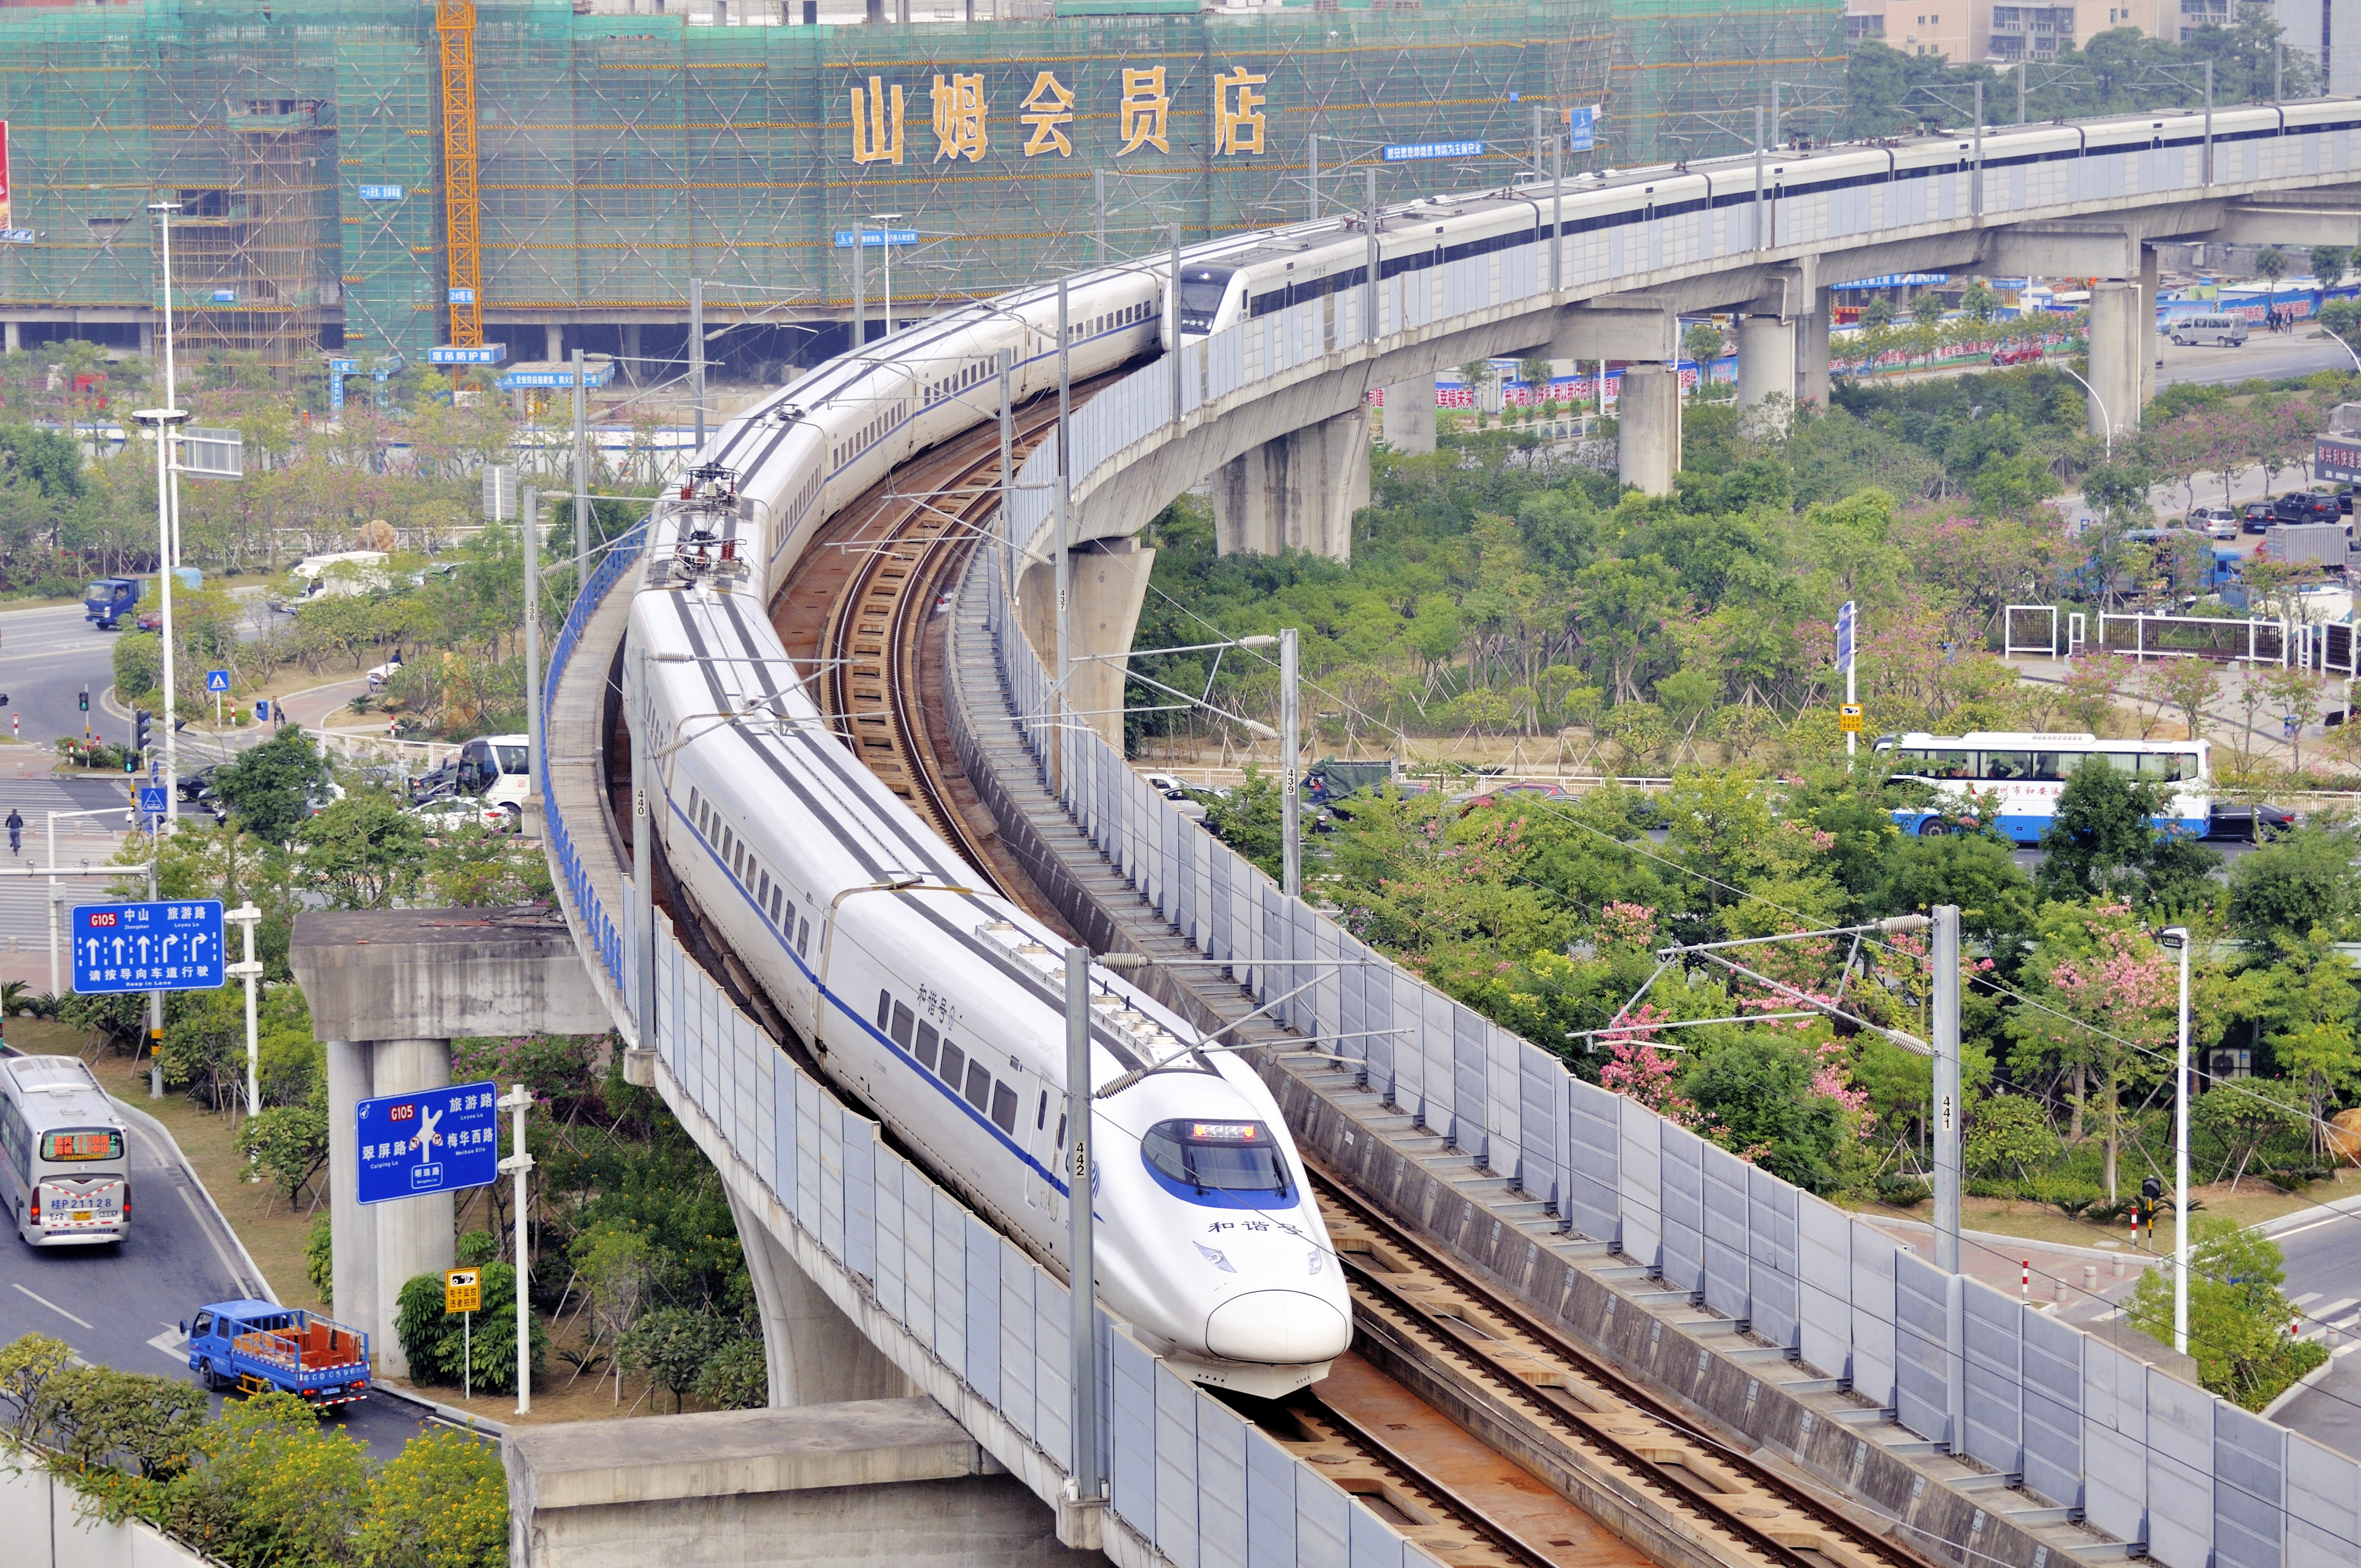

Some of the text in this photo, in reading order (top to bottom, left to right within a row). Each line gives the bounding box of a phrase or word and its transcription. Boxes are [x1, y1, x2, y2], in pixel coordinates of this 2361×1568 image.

[851, 66, 1266, 165] 山姆会员店
[450, 291, 473, 301] 2#塔吊
[433, 352, 489, 361] 塔吊防护棚
[91, 914, 116, 926] G105
[124, 908, 149, 922] 中山
[167, 906, 206, 921] 旅游路
[89, 965, 209, 982] 请按导向车道行驶
[917, 983, 948, 1024] 和谐号
[449, 1092, 493, 1113] 旅游路
[391, 1105, 414, 1120] G105
[448, 1127, 494, 1148] 梅华西路
[91, 1144, 110, 1153] 中山
[362, 1140, 407, 1162] 翠屏路
[1076, 1141, 1085, 1175] 442
[415, 1166, 440, 1178] 明珠路
[51, 1199, 112, 1209] 桂P21128
[1207, 1221, 1304, 1235] 和谐号
[450, 1288, 477, 1298] 电子监控
[450, 1298, 477, 1308] 违者拍照
